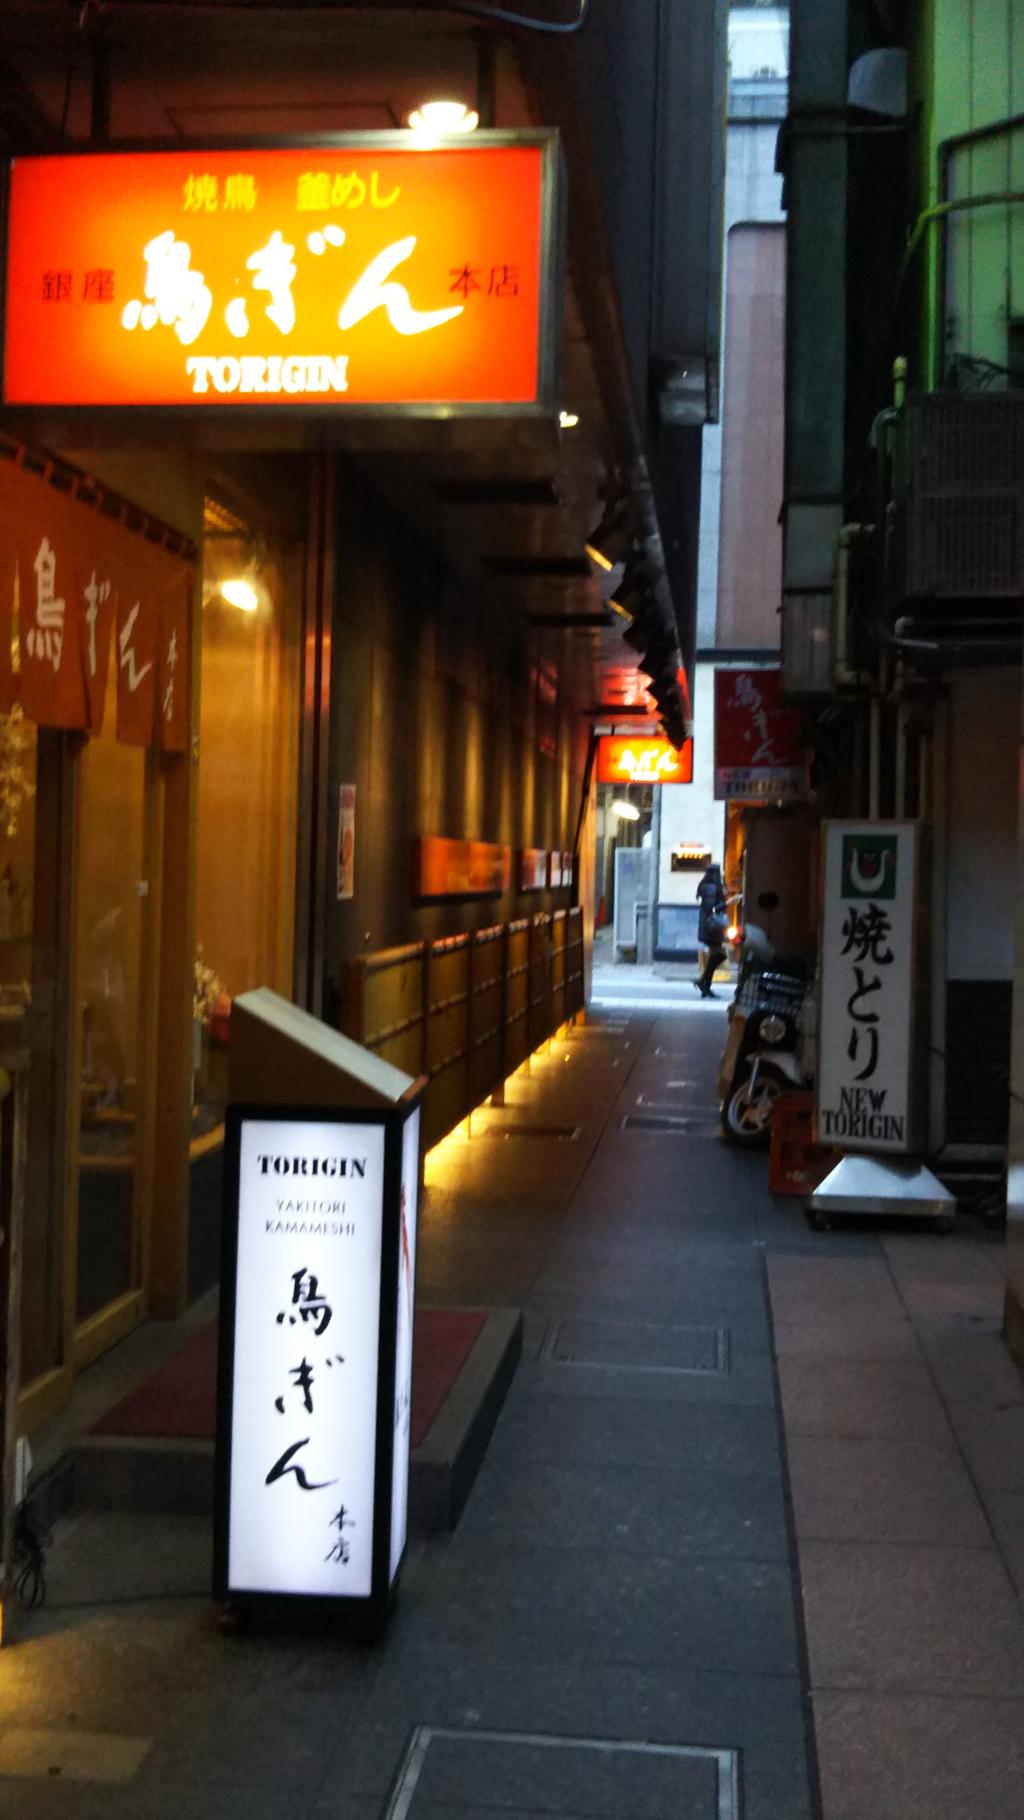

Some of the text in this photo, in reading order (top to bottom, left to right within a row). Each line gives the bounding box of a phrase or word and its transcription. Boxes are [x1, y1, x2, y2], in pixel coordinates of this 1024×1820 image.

[183, 171, 400, 212] 焼鳥 釜めし
[42, 267, 115, 303] 銀座
[122, 224, 464, 345] 鳥ぎん
[449, 263, 521, 298] 本店
[186, 356, 349, 393] TORIGIN
[840, 902, 894, 1081] 焼とり
[840, 1086, 887, 1113] NEW
[821, 1109, 905, 1142] TORIGIN
[257, 1154, 368, 1178] TORIGIN
[276, 1199, 346, 1214] YAKITORI
[265, 1218, 356, 1236] KAMAMESHI
[265, 1267, 345, 1490] 鳥ぎん
